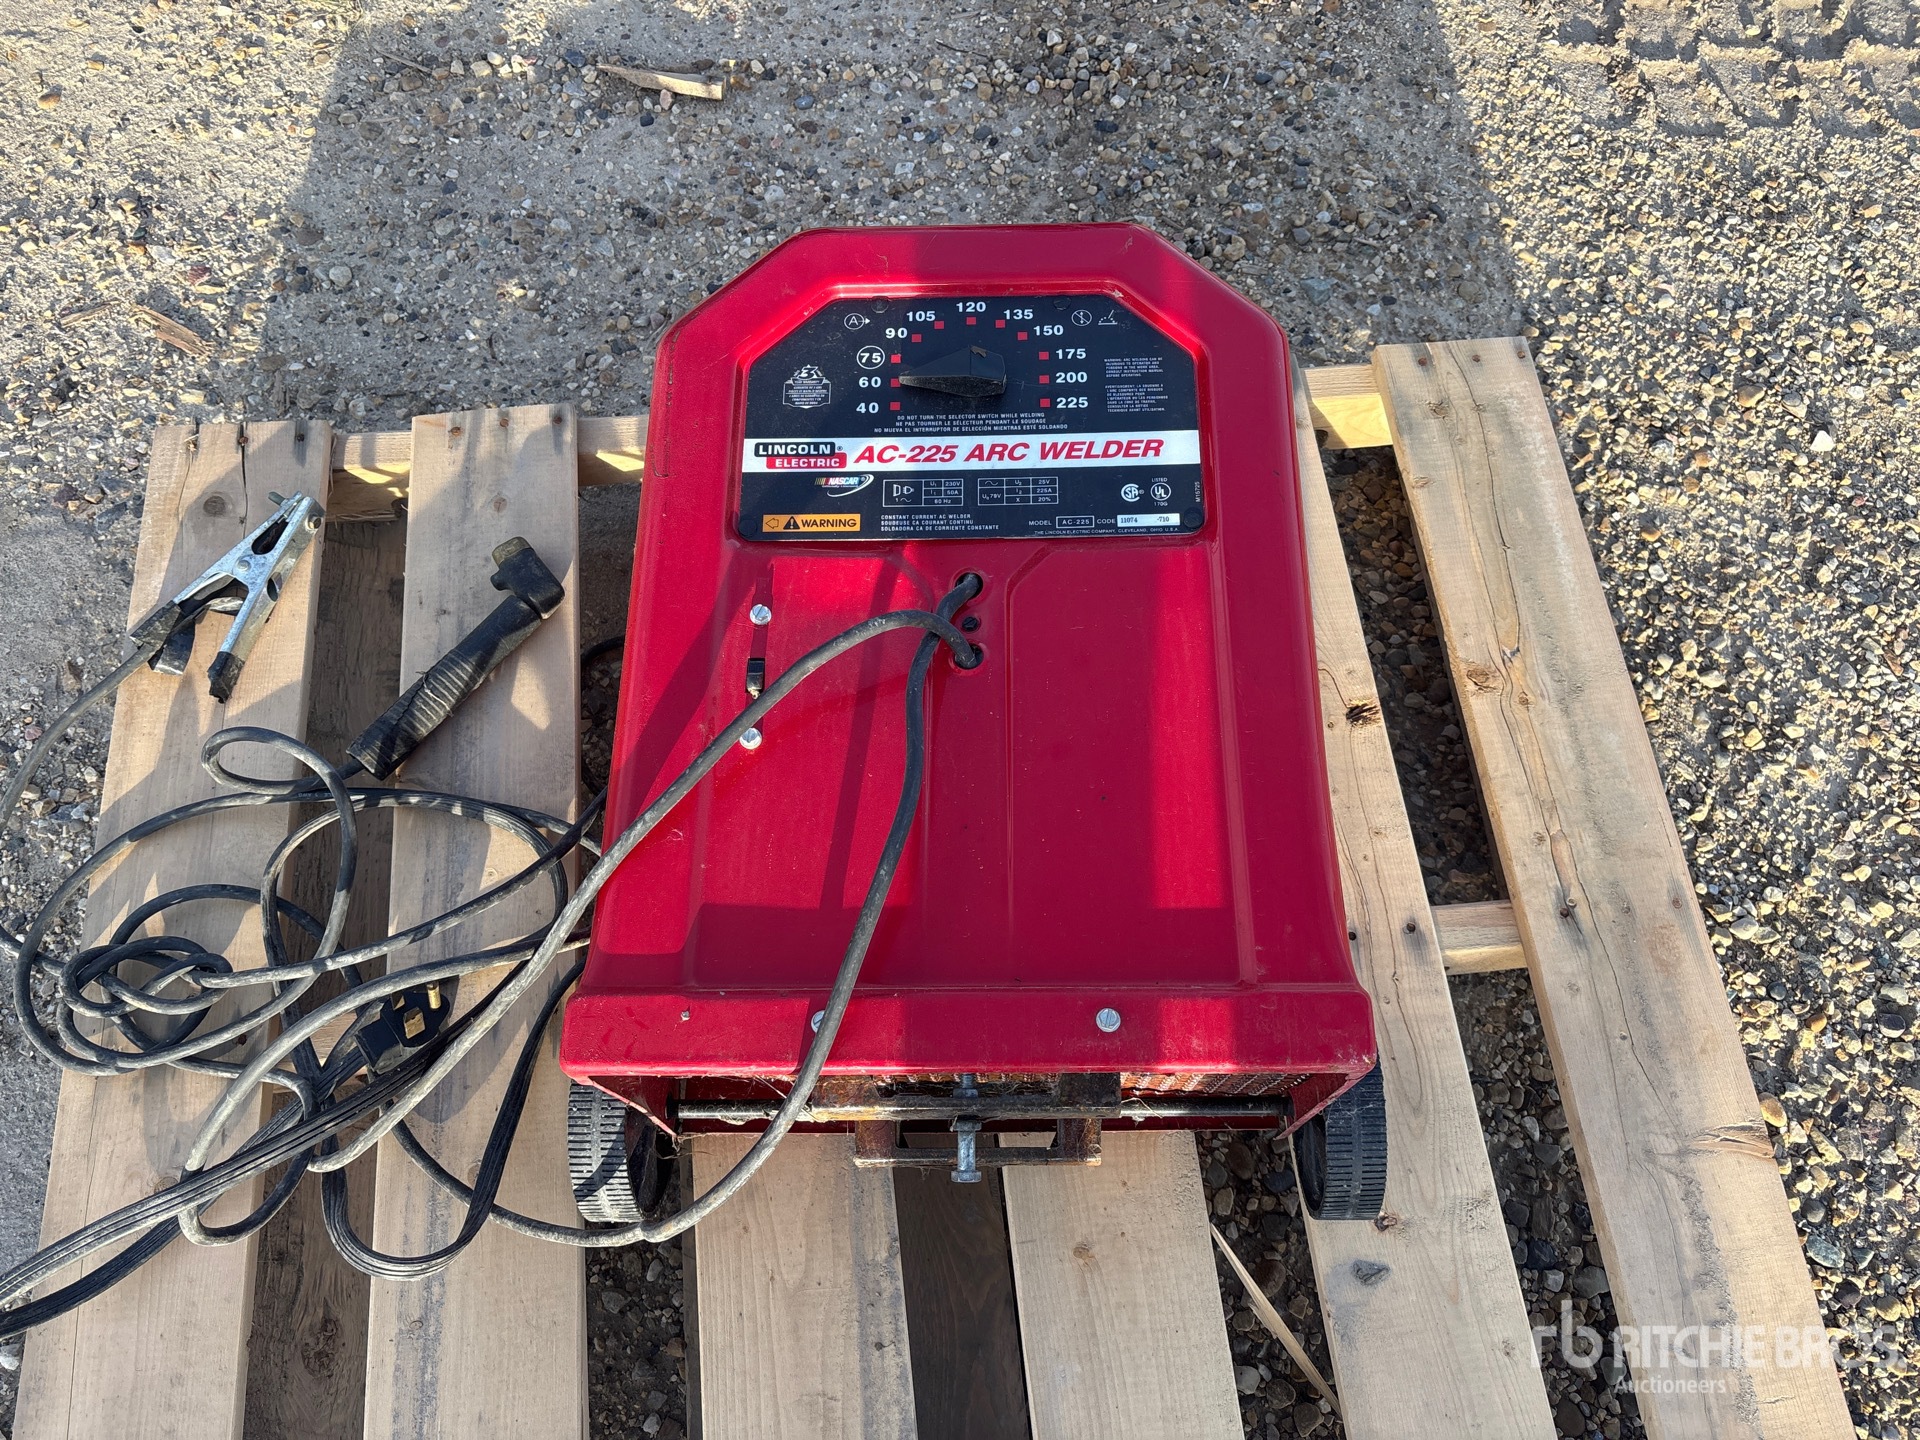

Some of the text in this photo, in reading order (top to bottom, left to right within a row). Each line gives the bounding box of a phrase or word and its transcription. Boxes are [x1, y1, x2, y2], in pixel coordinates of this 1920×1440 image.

[956, 302, 986, 312] 120
[907, 311, 936, 322] 105
[1004, 309, 1034, 320] 135
[885, 328, 907, 338] 90
[1034, 325, 1064, 336] 150
[860, 353, 881, 363] 75
[1055, 349, 1086, 359] 175
[859, 376, 881, 387] 60
[1055, 372, 1088, 383] 200
[1056, 397, 1088, 408] 225
[856, 403, 879, 413] 40
[759, 444, 831, 454] LINCOLN
[854, 439, 1164, 464] AC-225 ARC WELDER
[775, 458, 840, 467] ELECTRIC
[829, 477, 860, 485] NASCAR
[801, 518, 857, 528] WARNING
